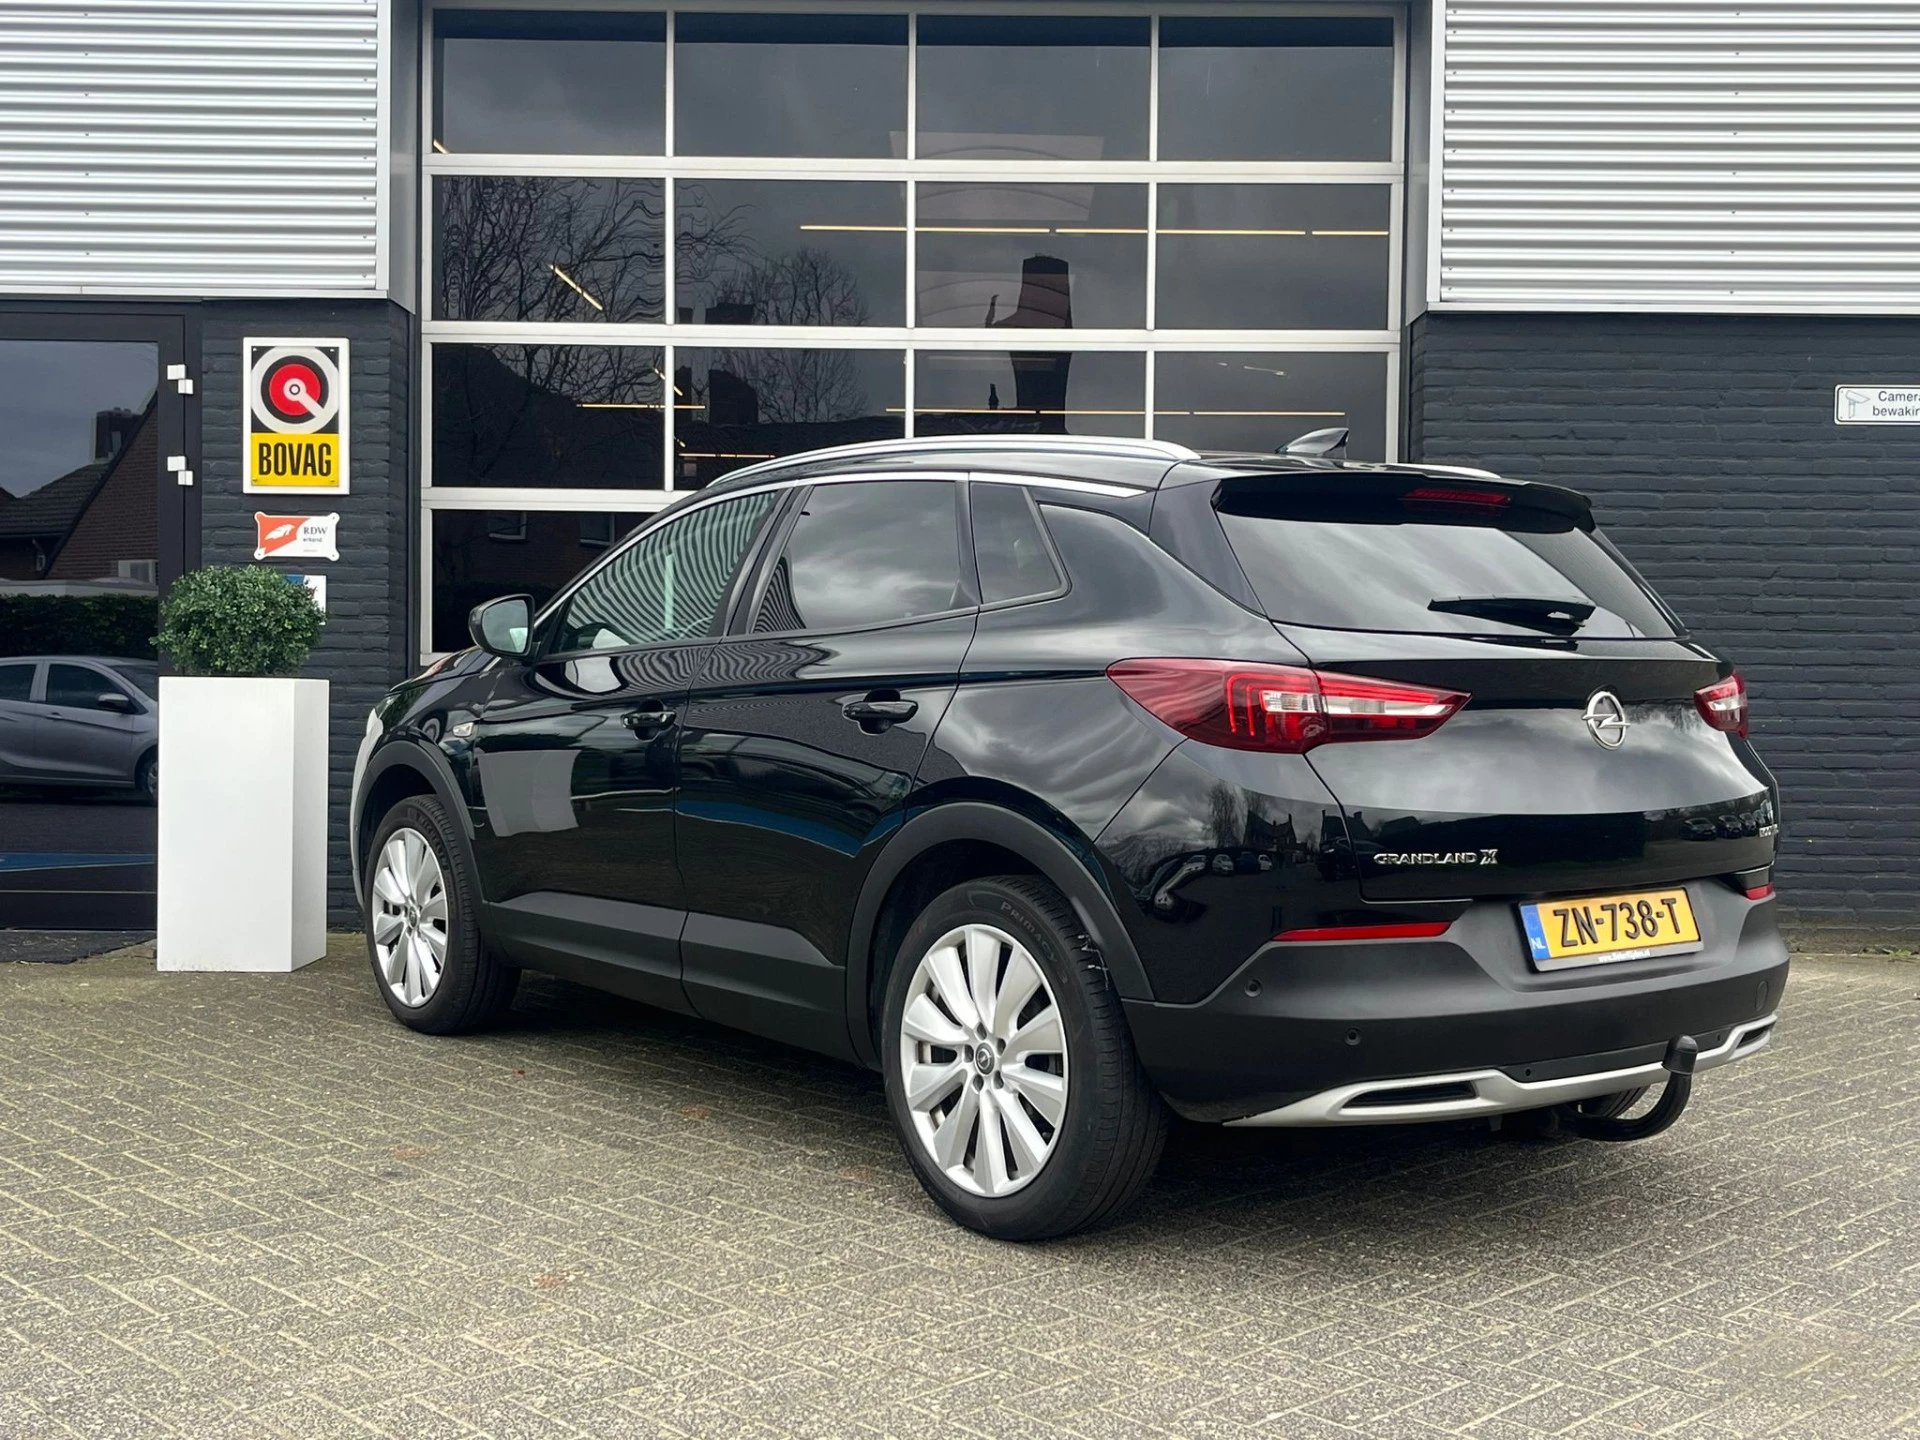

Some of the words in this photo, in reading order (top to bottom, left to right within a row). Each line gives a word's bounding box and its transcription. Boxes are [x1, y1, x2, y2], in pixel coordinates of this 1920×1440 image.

[1878, 390, 1920, 403] Camer
[258, 442, 332, 477] BOVAG
[303, 526, 328, 535] RDW
[1373, 852, 1478, 865] GRANDLAND
[1480, 848, 1499, 865] X
[1553, 897, 1681, 948] ZN-738-T
[1530, 937, 1546, 950] NL
